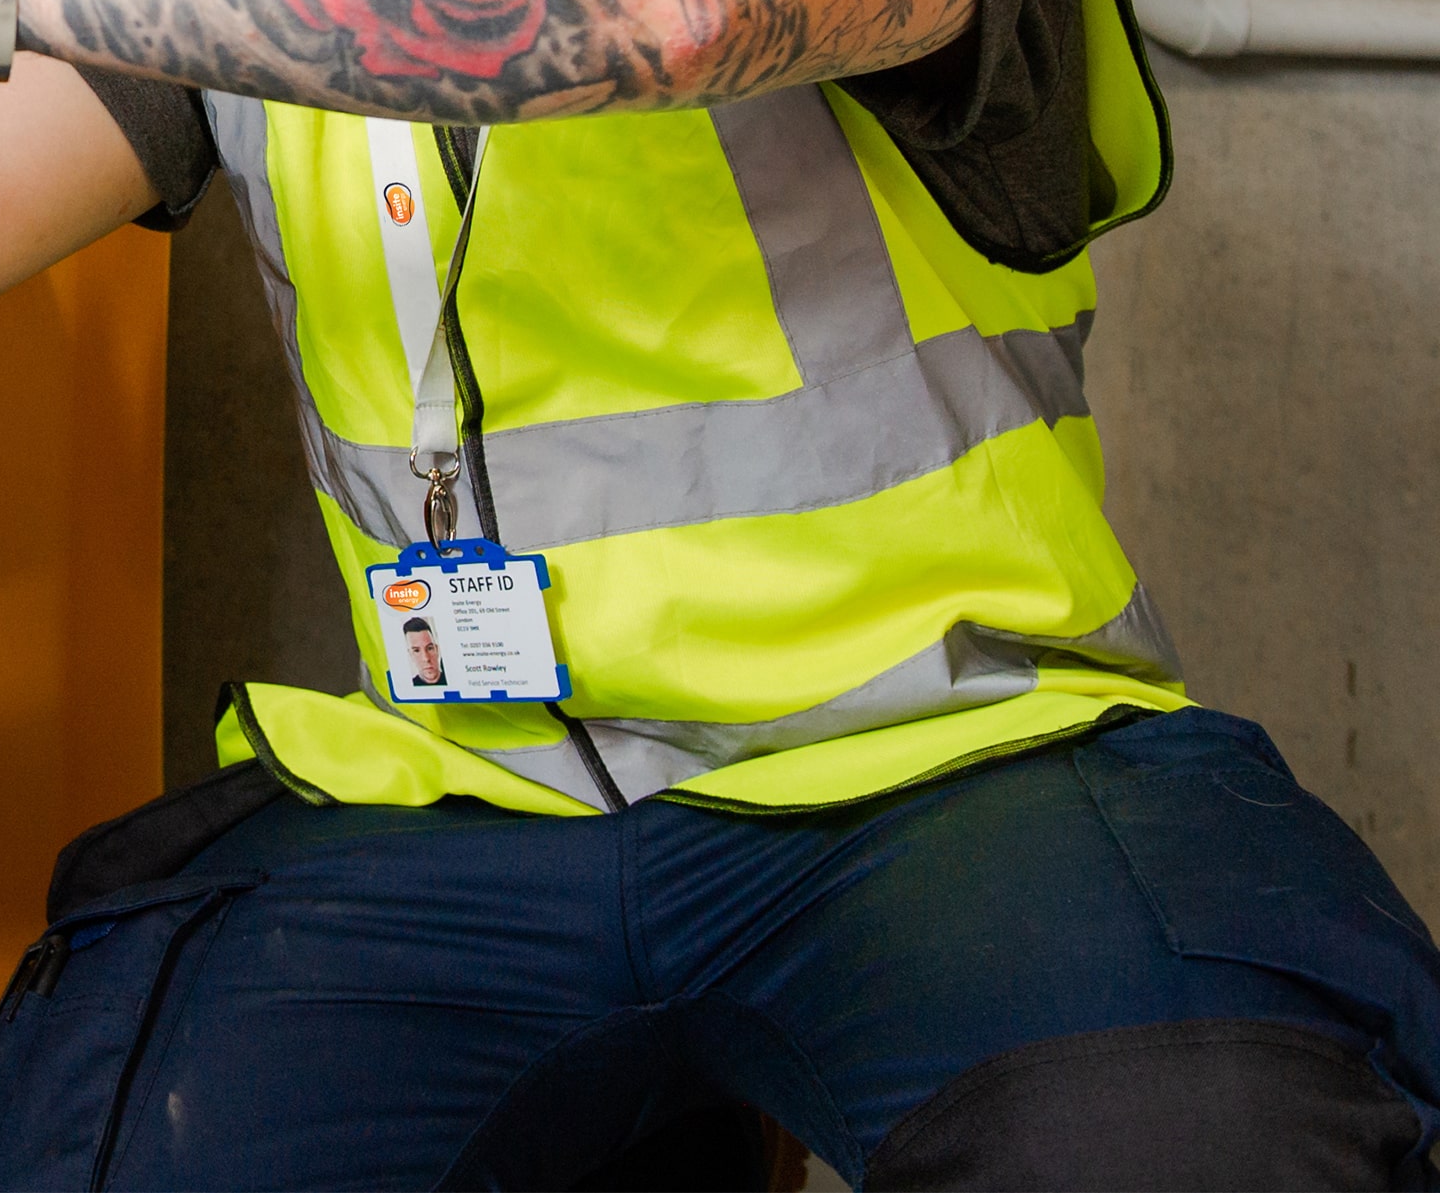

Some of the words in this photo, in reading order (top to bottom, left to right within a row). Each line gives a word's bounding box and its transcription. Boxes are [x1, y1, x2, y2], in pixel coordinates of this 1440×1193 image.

[392, 193, 405, 220] insite
[449, 576, 493, 593] STAFF
[497, 575, 514, 591] ID
[389, 588, 419, 598] insite
[465, 665, 482, 673] Scott
[482, 664, 507, 673] Rowley
